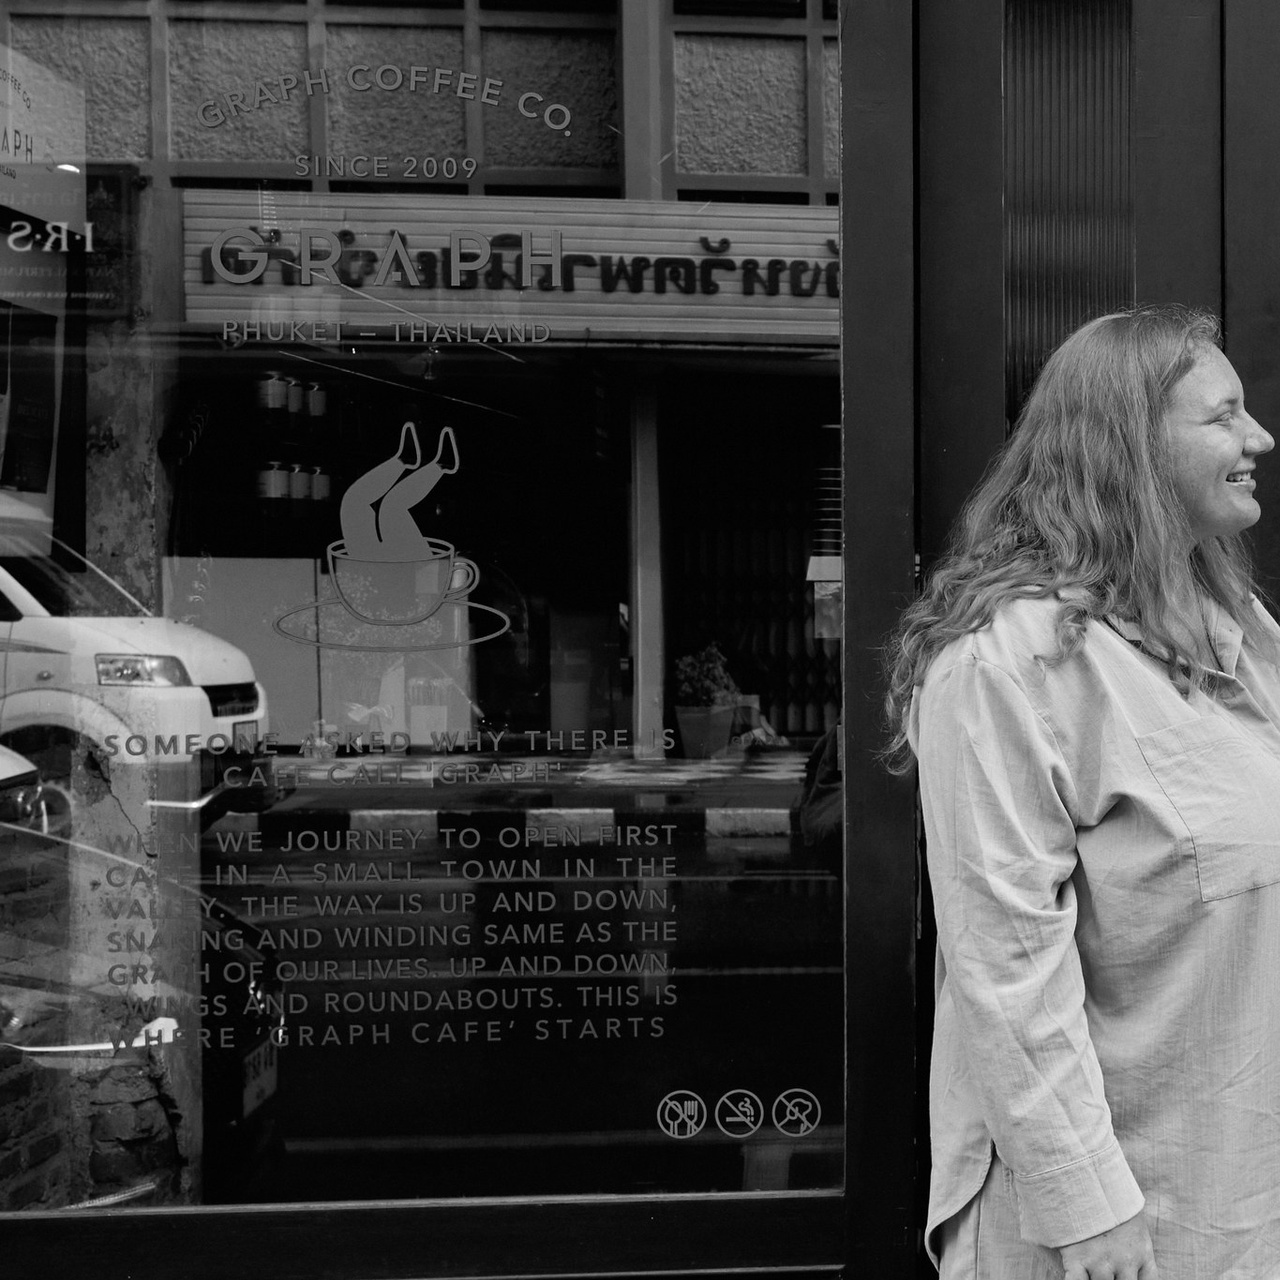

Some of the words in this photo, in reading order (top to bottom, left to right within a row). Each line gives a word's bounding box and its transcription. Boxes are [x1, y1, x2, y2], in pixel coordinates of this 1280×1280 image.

[196, 67, 330, 128] GRAPH
[347, 64, 504, 106] COFFEE
[517, 91, 572, 138] CO.
[294, 155, 389, 178] SINCE
[404, 155, 478, 179] 2009
[210, 228, 563, 287] GRAPH
[223, 321, 342, 343] PHUKET
[390, 322, 552, 343] THAILAND
[104, 732, 279, 756] SOMEONE
[300, 731, 411, 754] ASKED
[431, 730, 504, 752] WHY
[525, 729, 629, 751] THERE
[651, 728, 676, 750] IS
[223, 765, 310, 787] CAFE
[327, 764, 409, 785] CALL
[216, 831, 263, 853] WE
[280, 829, 424, 853] JOURNEY
[440, 827, 481, 849] TO
[499, 826, 581, 848] OPEN
[600, 825, 677, 846] FIRST
[216, 864, 248, 886] IN
[272, 863, 292, 884] A
[313, 862, 420, 883] SMALL
[440, 859, 541, 880] TOWN
[564, 858, 595, 878] IN
[617, 857, 677, 878] THE
[242, 895, 299, 917] THE
[314, 894, 383, 916] WAY
[400, 893, 423, 914] IS
[440, 892, 476, 913] UP
[492, 891, 557, 913] AND
[574, 890, 676, 913] DOWN,
[107, 929, 245, 953] SNAKING
[257, 927, 322, 951] AND
[334, 925, 472, 948] WINDING
[484, 923, 564, 945] SAME
[576, 922, 612, 944] AS
[623, 921, 677, 942] THE
[107, 961, 210, 986] GRAPH
[223, 960, 264, 984] OF
[276, 959, 340, 982] OUR
[352, 957, 437, 981] LIVES.
[450, 956, 486, 979] UP
[499, 954, 562, 977] AND
[574, 953, 676, 976] DOWN,
[112, 994, 228, 1017] WINGS
[243, 992, 309, 1015] AND
[324, 988, 563, 1012] ROUNDABOUTS.
[577, 985, 640, 1007] THIS
[656, 984, 678, 1005] IS
[109, 1026, 235, 1051] WHERE
[535, 1016, 665, 1041] STARTS
